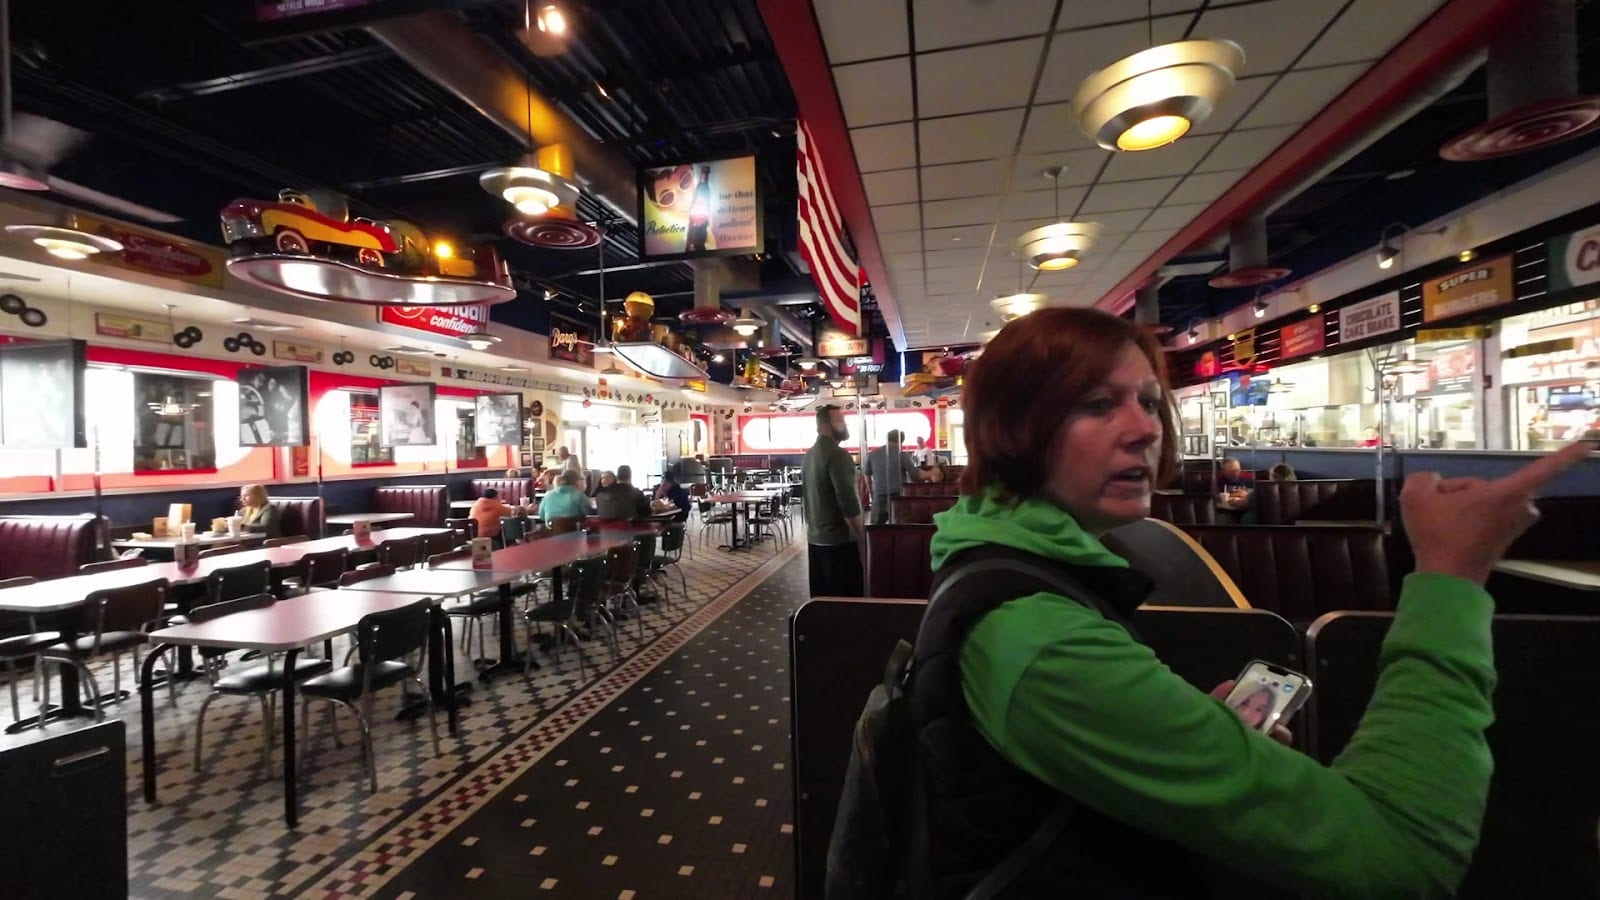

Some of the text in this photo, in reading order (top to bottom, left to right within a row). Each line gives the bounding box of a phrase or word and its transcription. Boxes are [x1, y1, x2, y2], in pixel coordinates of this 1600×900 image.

[1439, 269, 1489, 292] SUPER
[1345, 301, 1392, 326] CHOCOLATE
[1344, 315, 1396, 340] CAKE SHAKE
